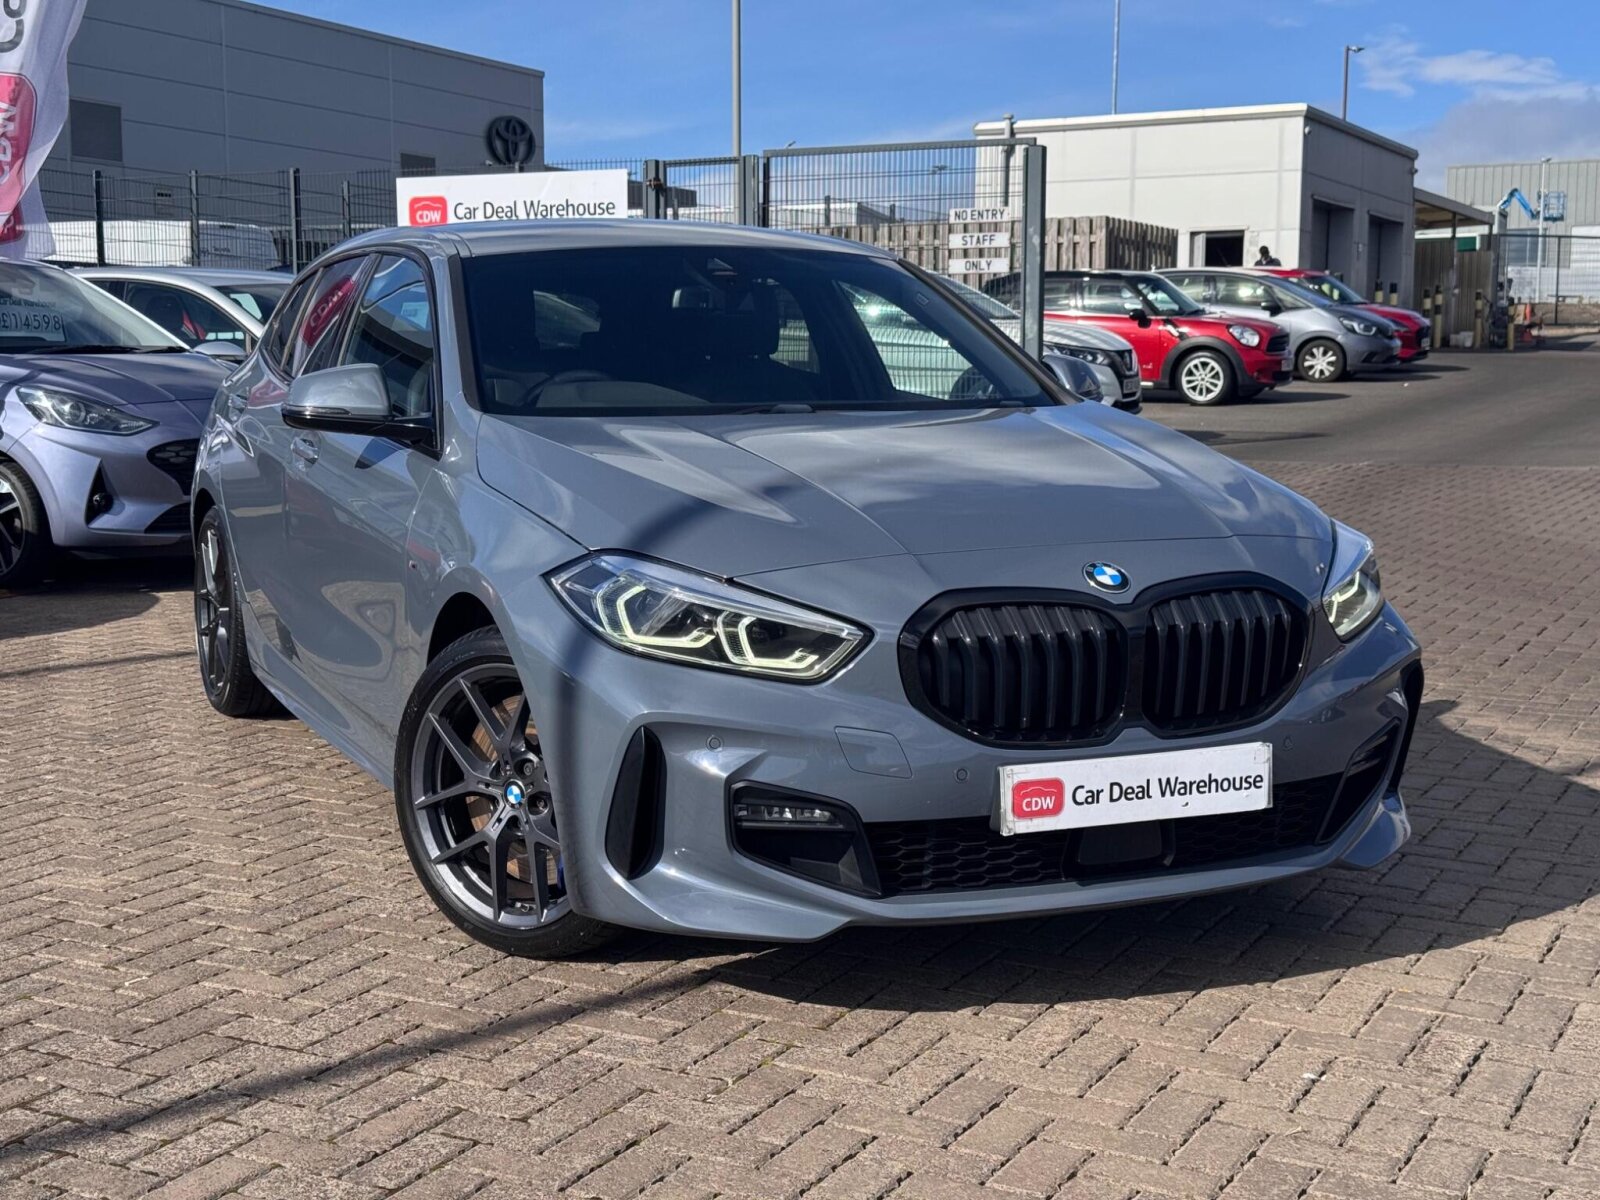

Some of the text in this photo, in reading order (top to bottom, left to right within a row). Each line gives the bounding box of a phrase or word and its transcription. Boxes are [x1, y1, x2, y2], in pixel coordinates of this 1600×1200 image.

[415, 198, 616, 224] CDW Car Deal Warehouse
[954, 208, 1005, 221] NO ENTRY
[961, 234, 995, 246] STAFF
[964, 260, 992, 271] ONLY
[1, 312, 61, 331] £14598
[1022, 772, 1264, 812] CDW Car Deal Warehouse
